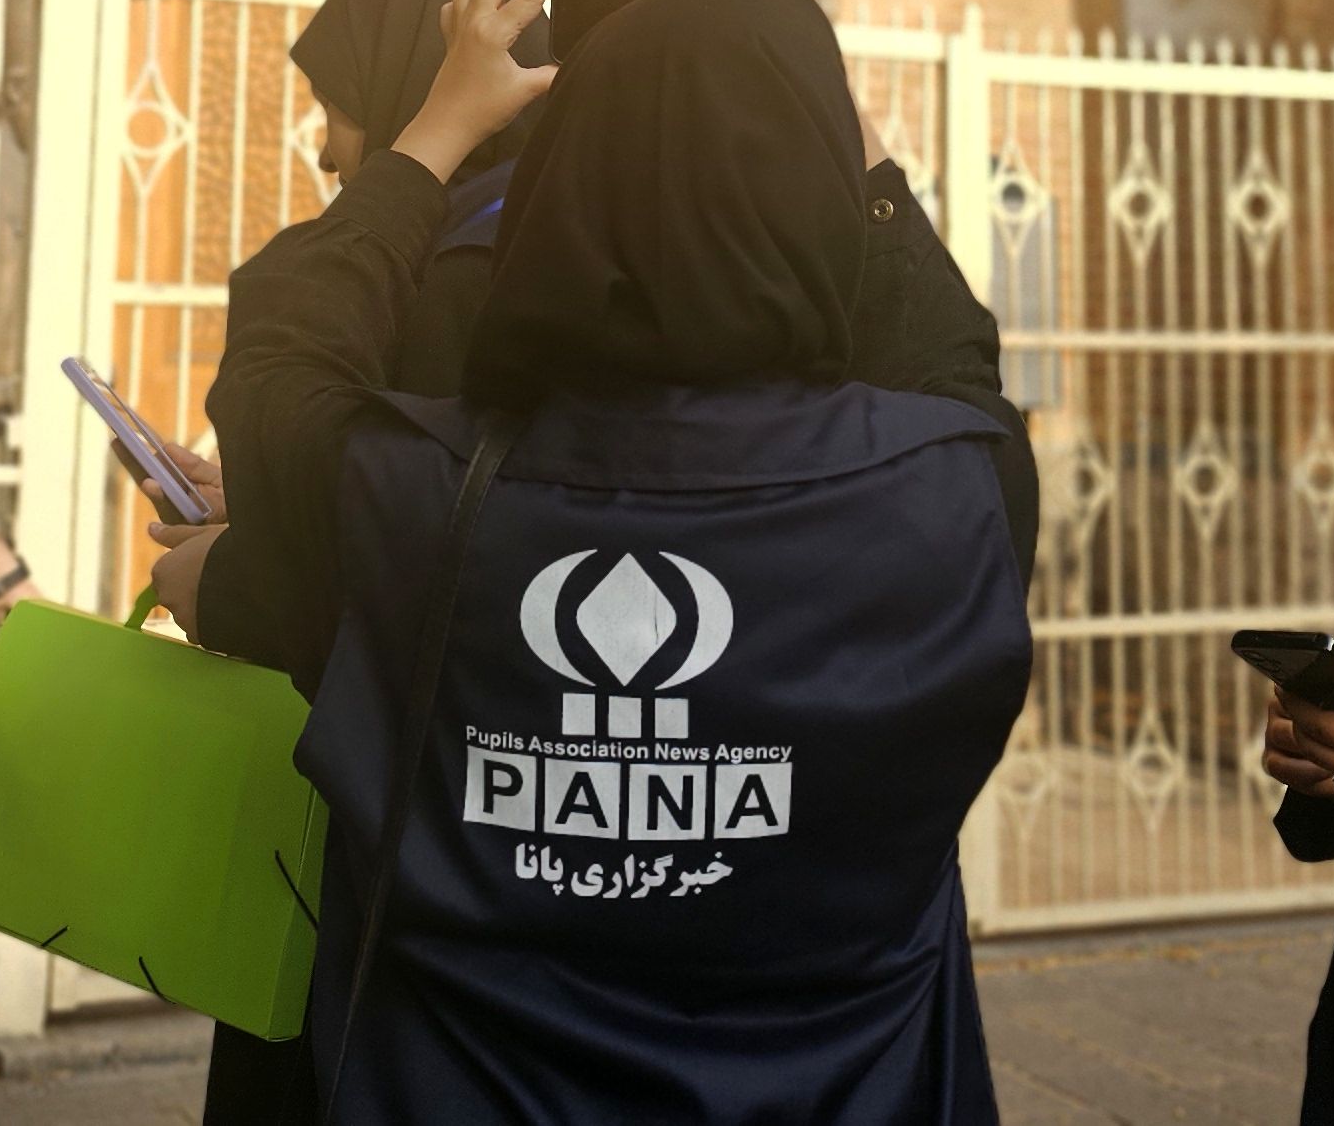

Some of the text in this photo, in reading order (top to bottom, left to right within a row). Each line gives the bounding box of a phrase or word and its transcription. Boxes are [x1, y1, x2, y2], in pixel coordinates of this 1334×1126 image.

[466, 725, 792, 764] Pupils Association News Agency
[482, 758, 779, 832] PANA
[515, 843, 734, 899] خبرگزاری پانا
